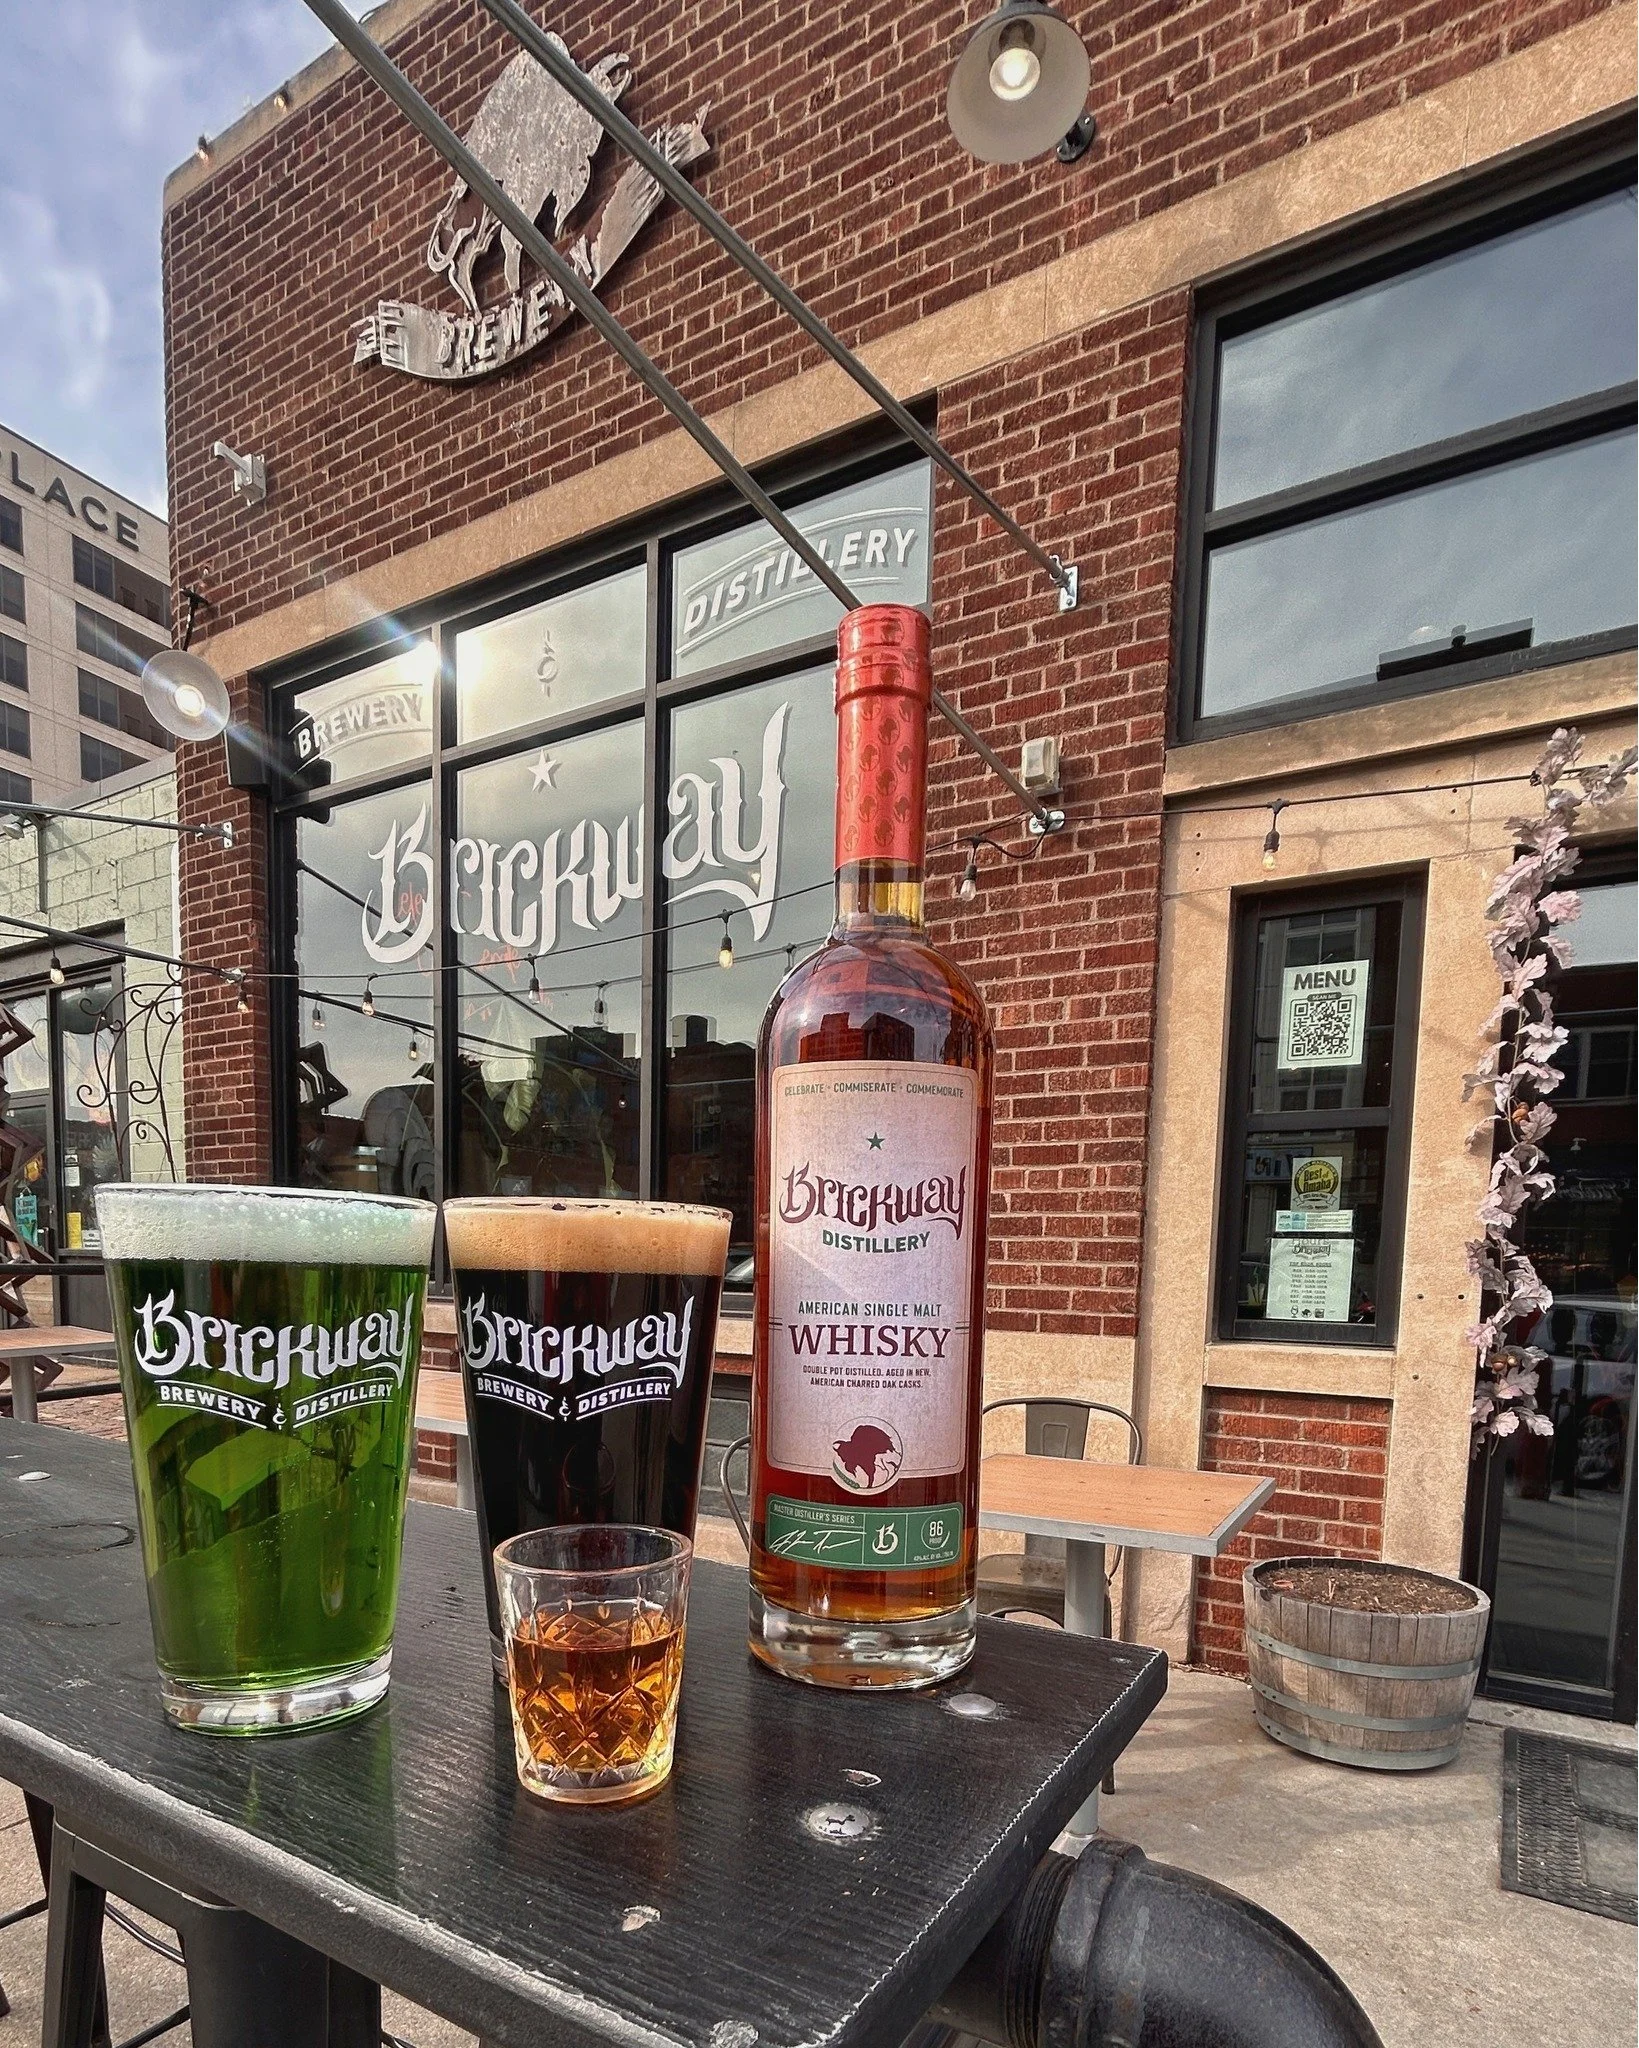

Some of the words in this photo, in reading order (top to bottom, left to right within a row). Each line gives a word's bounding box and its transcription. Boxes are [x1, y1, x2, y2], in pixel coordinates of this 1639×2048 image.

[0, 449, 139, 552] LACE
[298, 692, 423, 758] BREWERY
[683, 527, 916, 634] DISTILLERY
[361, 701, 788, 963] Brickway
[1293, 967, 1357, 991] MENU
[784, 1083, 824, 1097] CELEBRATE
[833, 1082, 896, 1093] COMMISERATE
[906, 1083, 964, 1098] COMMEMORATE
[1303, 1178, 1331, 1192] Omaha
[1304, 1168, 1322, 1181] Best
[778, 1160, 967, 1241] Brickway
[822, 1229, 931, 1253] DISTILLERY
[798, 1301, 859, 1316] AMERICAN
[864, 1303, 908, 1317] SINGLE
[913, 1303, 942, 1317] MALT
[133, 1288, 415, 1390] Brickway
[461, 1292, 695, 1389] Brickway
[788, 1324, 951, 1358] WHISKY
[803, 1365, 828, 1374] DOUBLE
[830, 1367, 843, 1375] POT
[886, 1368, 904, 1377] AGED
[906, 1369, 913, 1377] IN
[810, 1377, 845, 1387] AMERICAN
[846, 1379, 880, 1388] CHARRED
[882, 1380, 897, 1388] OAK
[160, 1384, 261, 1421] BREWERY
[295, 1384, 393, 1421] DISTILLERY
[477, 1377, 550, 1411] BREWERY
[578, 1382, 671, 1414] DISTILLERY
[773, 1503, 794, 1517] MASTER
[794, 1509, 830, 1522] DISTILLER'S
[831, 1514, 855, 1524] SERIES
[929, 1520, 944, 1537] 86
